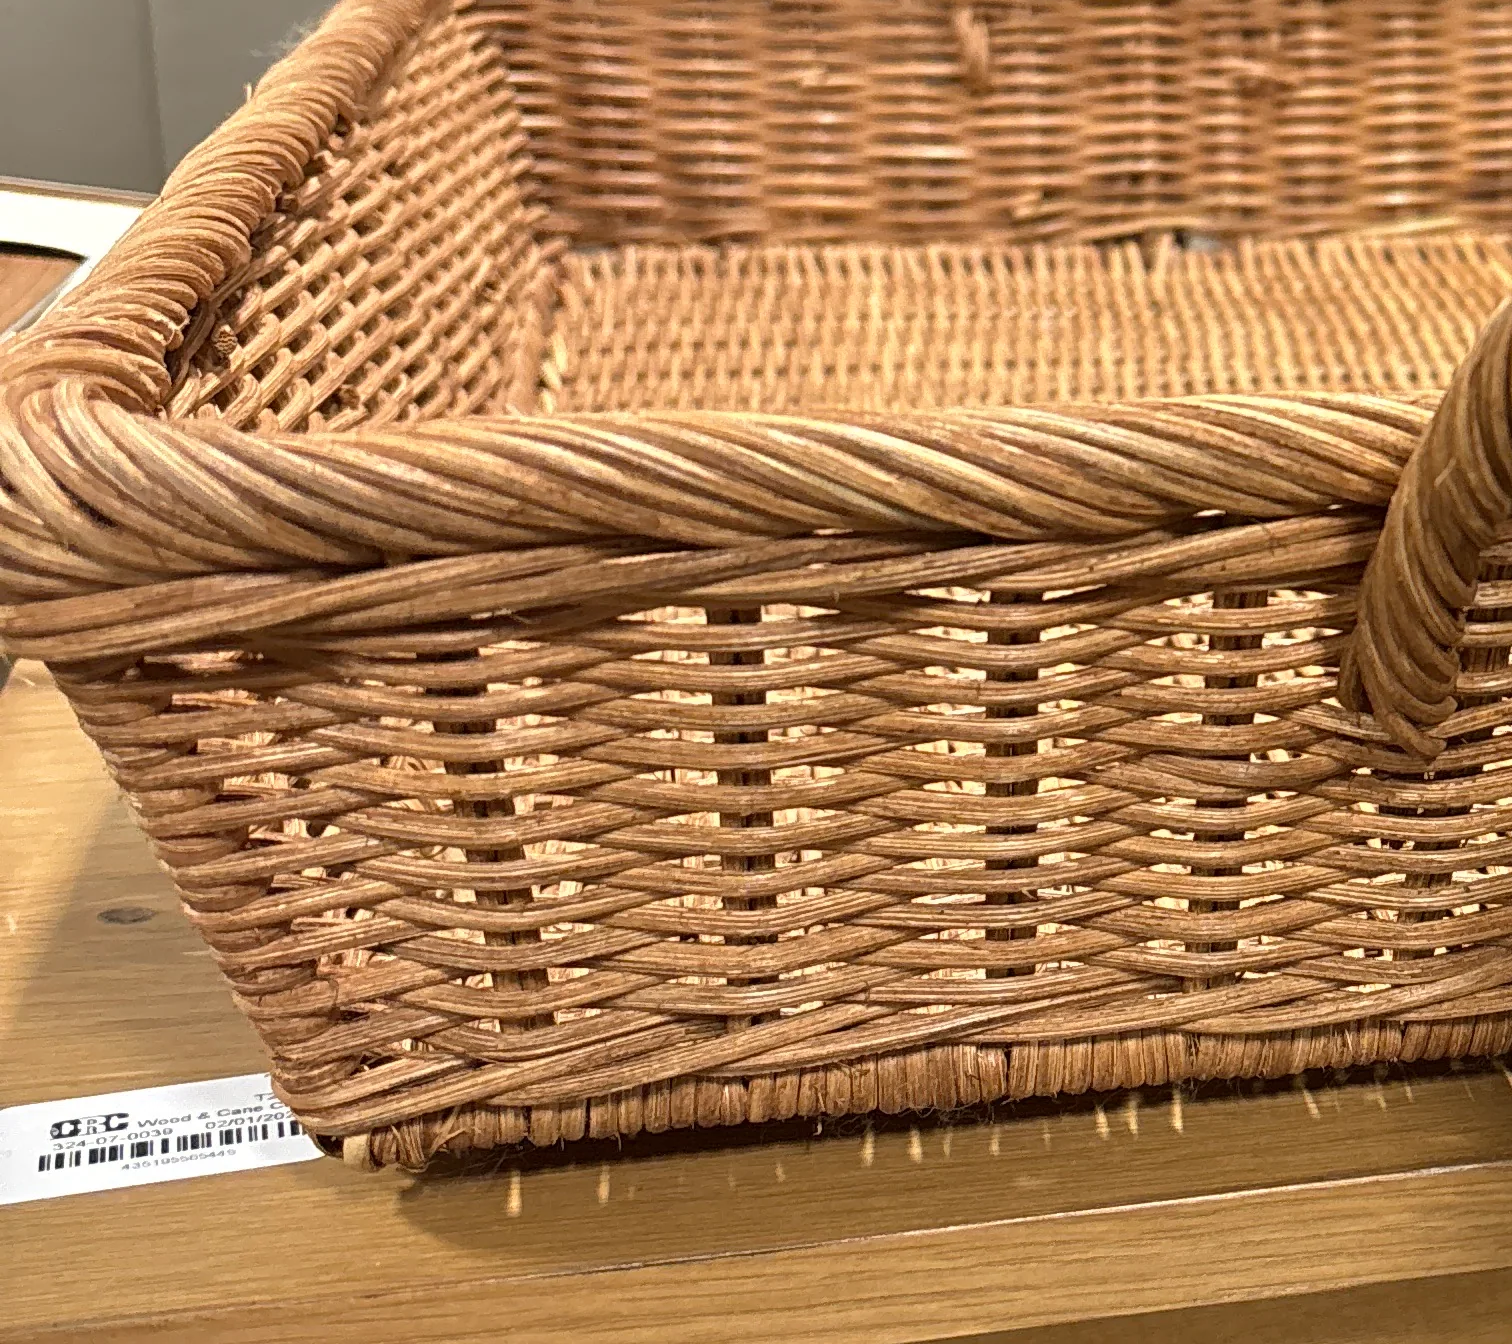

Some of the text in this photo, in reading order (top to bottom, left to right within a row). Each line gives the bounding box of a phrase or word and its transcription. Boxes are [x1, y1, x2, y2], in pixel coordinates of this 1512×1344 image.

[137, 1114, 192, 1128] Wood
[197, 1112, 211, 1121] &
[217, 1105, 263, 1117] Cane
[205, 1110, 293, 1129] 02/01/202
